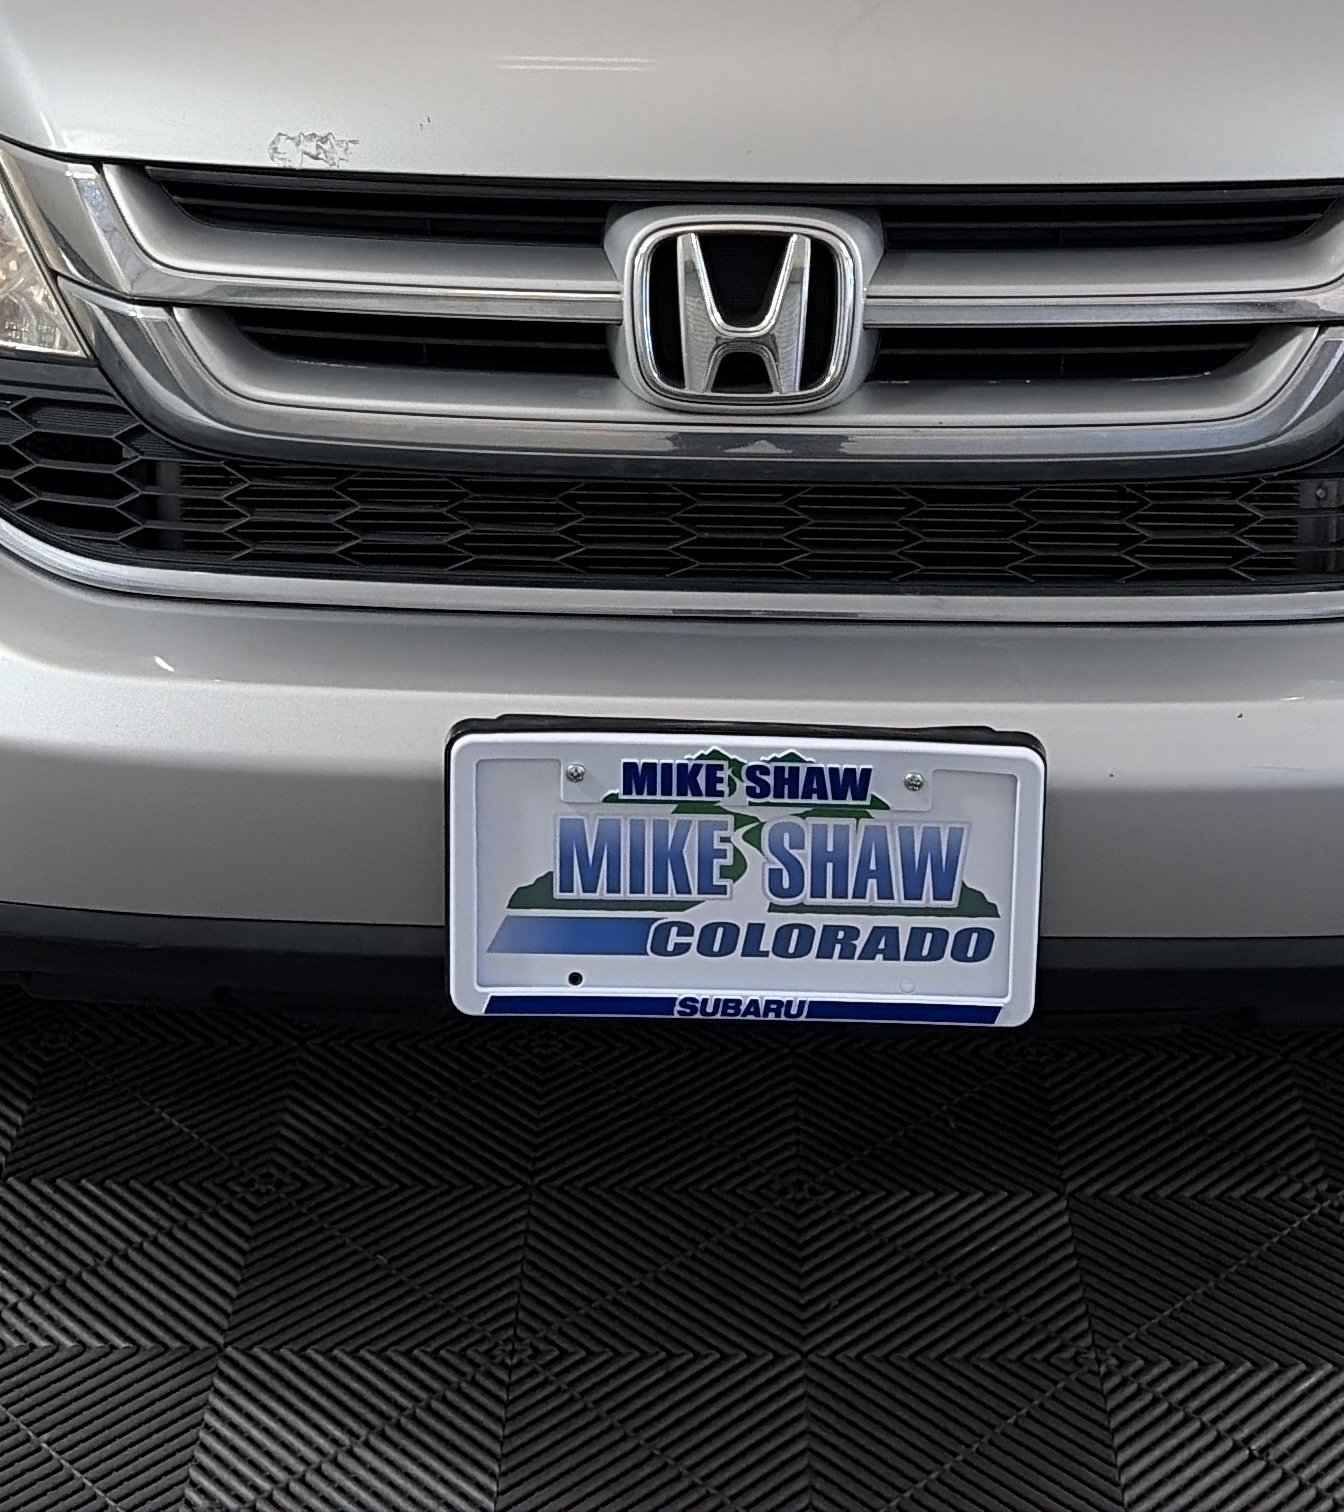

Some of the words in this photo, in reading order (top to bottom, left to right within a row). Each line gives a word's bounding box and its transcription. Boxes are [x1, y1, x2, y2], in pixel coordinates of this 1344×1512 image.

[621, 761, 726, 798] MIKE
[744, 763, 874, 802] SHAW
[557, 816, 731, 896] MIKE
[766, 819, 966, 903] SHAW
[649, 920, 996, 964] COLORADO
[676, 996, 808, 1020] SUBARU
